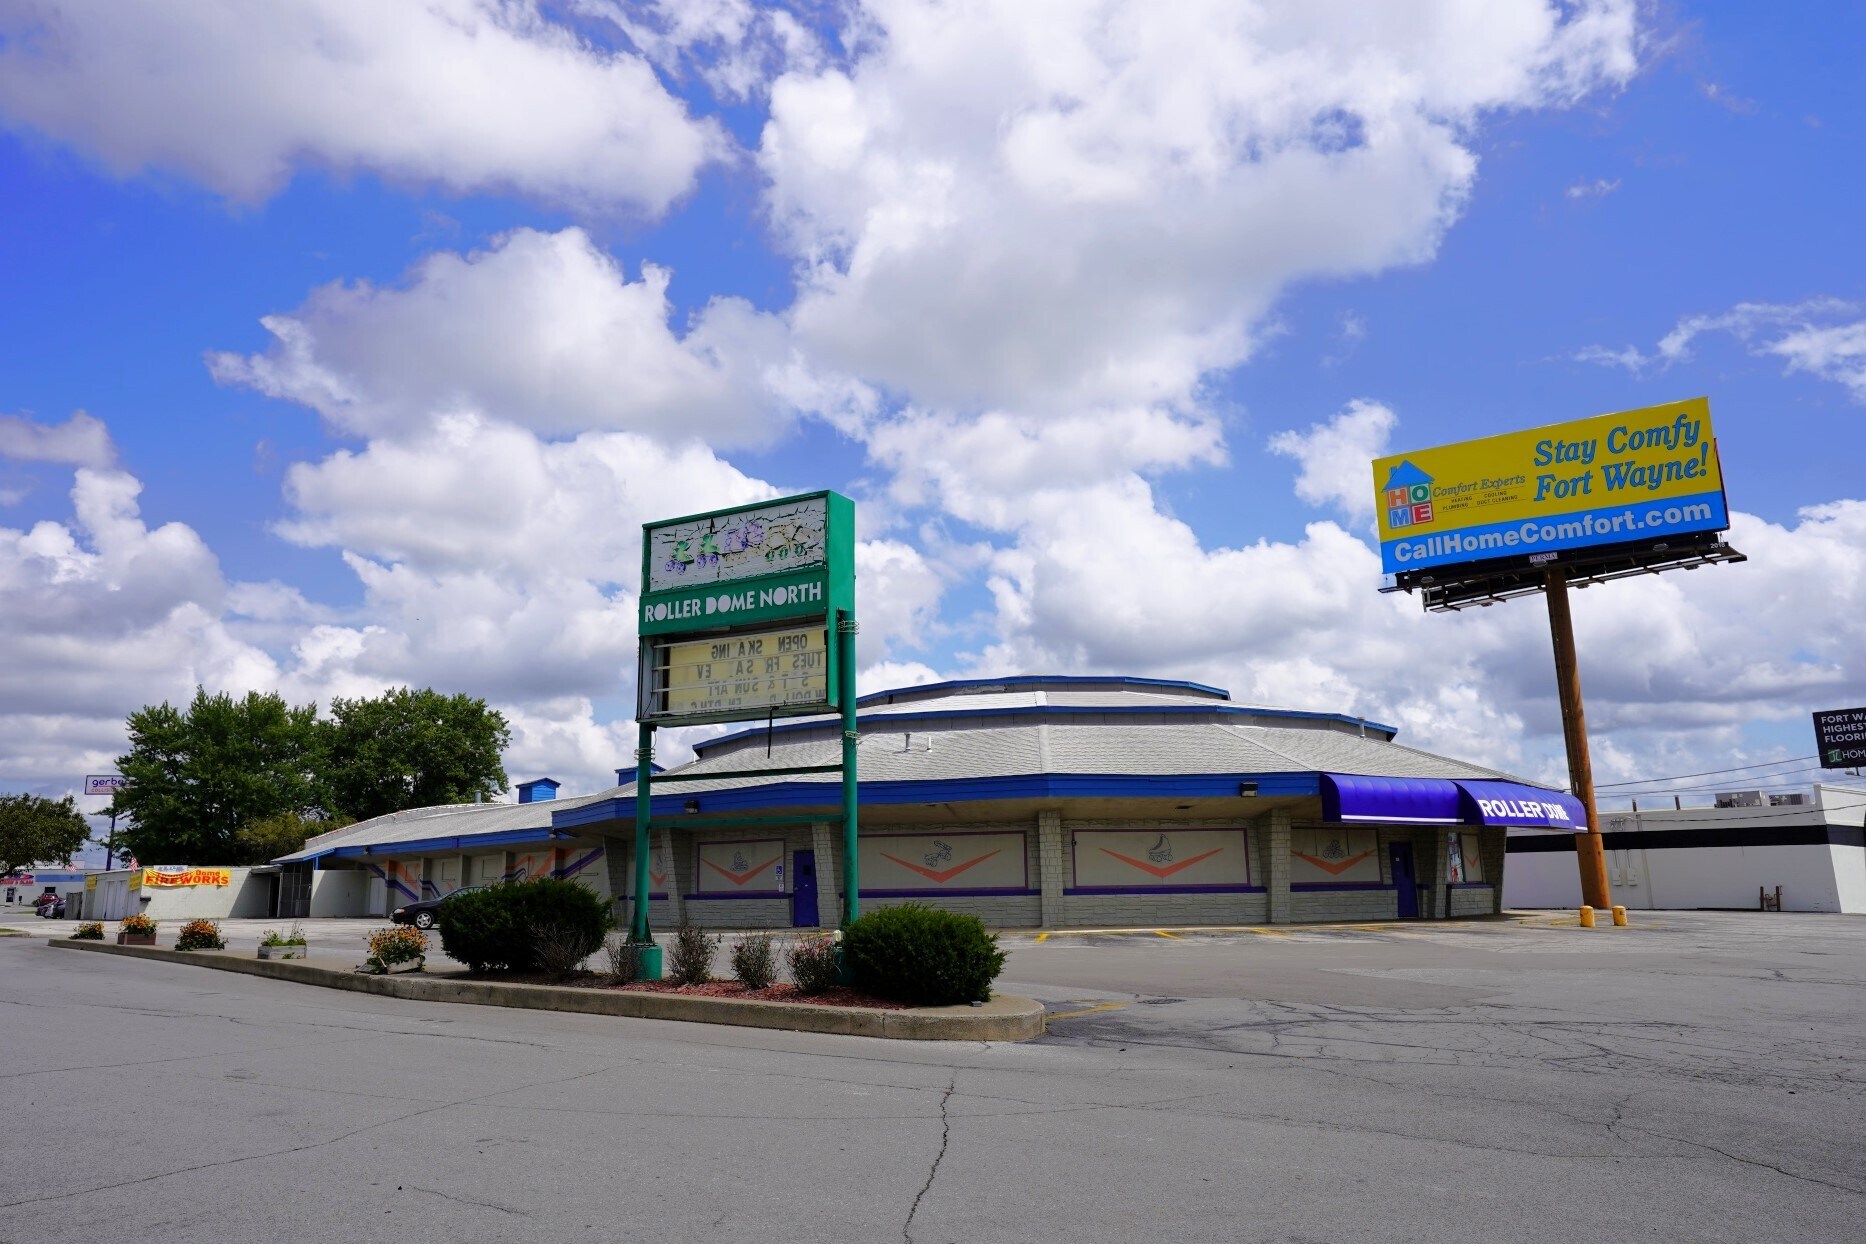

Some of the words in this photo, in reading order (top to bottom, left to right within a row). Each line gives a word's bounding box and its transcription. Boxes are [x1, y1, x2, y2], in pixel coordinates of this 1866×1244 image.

[1533, 439, 1597, 466] Stay
[1607, 414, 1700, 454] Comfy
[1533, 470, 1594, 502] Fort
[1601, 442, 1708, 491] Wayne!
[1432, 482, 1478, 498] Comfort
[1480, 474, 1526, 490] Experts
[1484, 490, 1507, 498] COOLING
[1442, 502, 1469, 511] PLUMBING
[1476, 498, 1491, 506] DUCT
[1492, 494, 1518, 504] CLEANING
[1394, 502, 1712, 562] CallHomeComfort.com
[644, 598, 702, 622] ROLLER
[705, 591, 756, 615] DOME
[760, 581, 822, 608] NORTH
[1821, 714, 1849, 724] FORT
[1824, 732, 1866, 743] FLOORI
[1477, 799, 1545, 818] ROLLER
[1541, 802, 1570, 820] DOME
[145, 875, 229, 885] FIREWORKS
